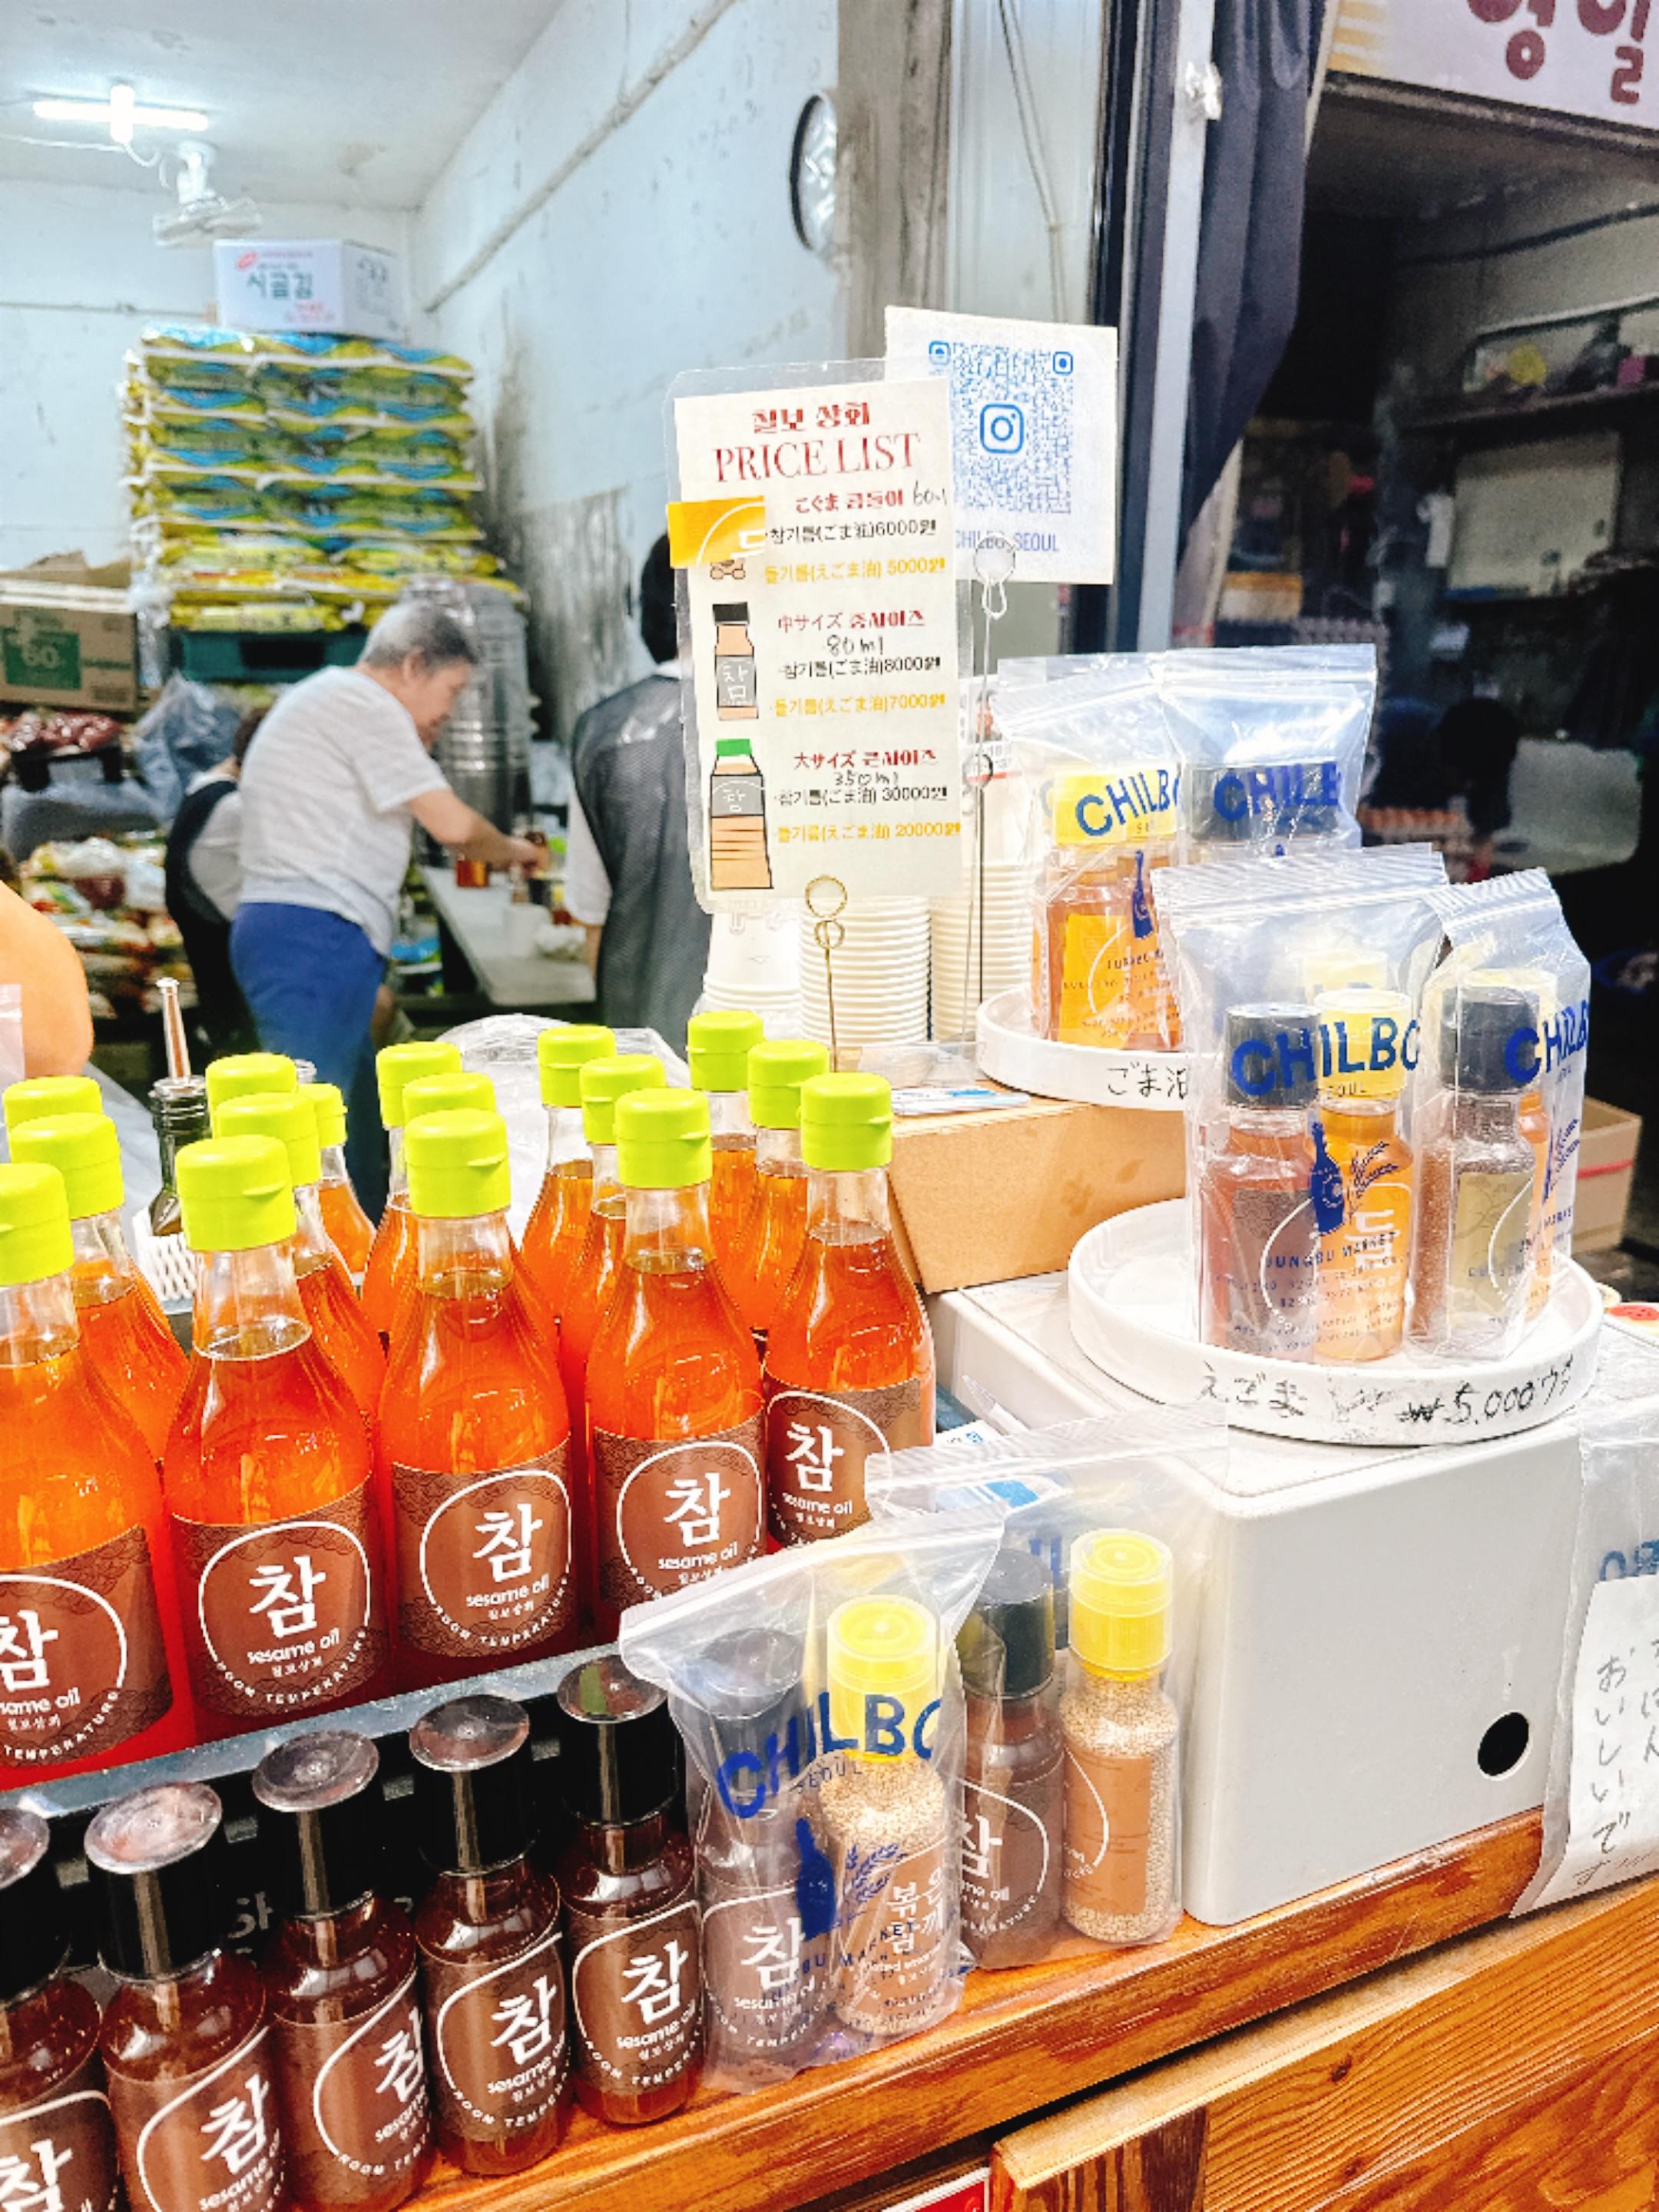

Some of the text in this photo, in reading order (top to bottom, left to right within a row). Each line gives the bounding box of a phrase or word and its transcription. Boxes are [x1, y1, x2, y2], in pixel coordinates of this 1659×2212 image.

[752, 402, 870, 434] 칠보 상회
[714, 432, 921, 483] PRICE LIST
[1013, 532, 1060, 551] SEOUL
[1075, 769, 1181, 836] CHILB
[1318, 1081, 1366, 1098] EOUL
[786, 1421, 845, 1493] 참
[663, 1472, 731, 1548] 참
[782, 1492, 853, 1515] sesame oil
[473, 1502, 544, 1583] 참
[658, 1541, 738, 1569] sesame oil
[249, 1555, 326, 1638] 참
[465, 1584, 529, 1608] sesame
[0, 1610, 59, 1693] 참
[247, 1628, 340, 1664] sesame oil
[0, 1687, 81, 1716] same oil
[621, 1939, 689, 2025] 참
[740, 1917, 805, 1991] 참
[490, 1975, 558, 2065] 참
[616, 2020, 680, 2049] sesame
[374, 2006, 424, 2103] 참
[487, 2056, 552, 2094] sesame
[200, 2073, 270, 2175] 참
[0, 2138, 73, 2212] 참
[199, 2157, 268, 2211] sesame
